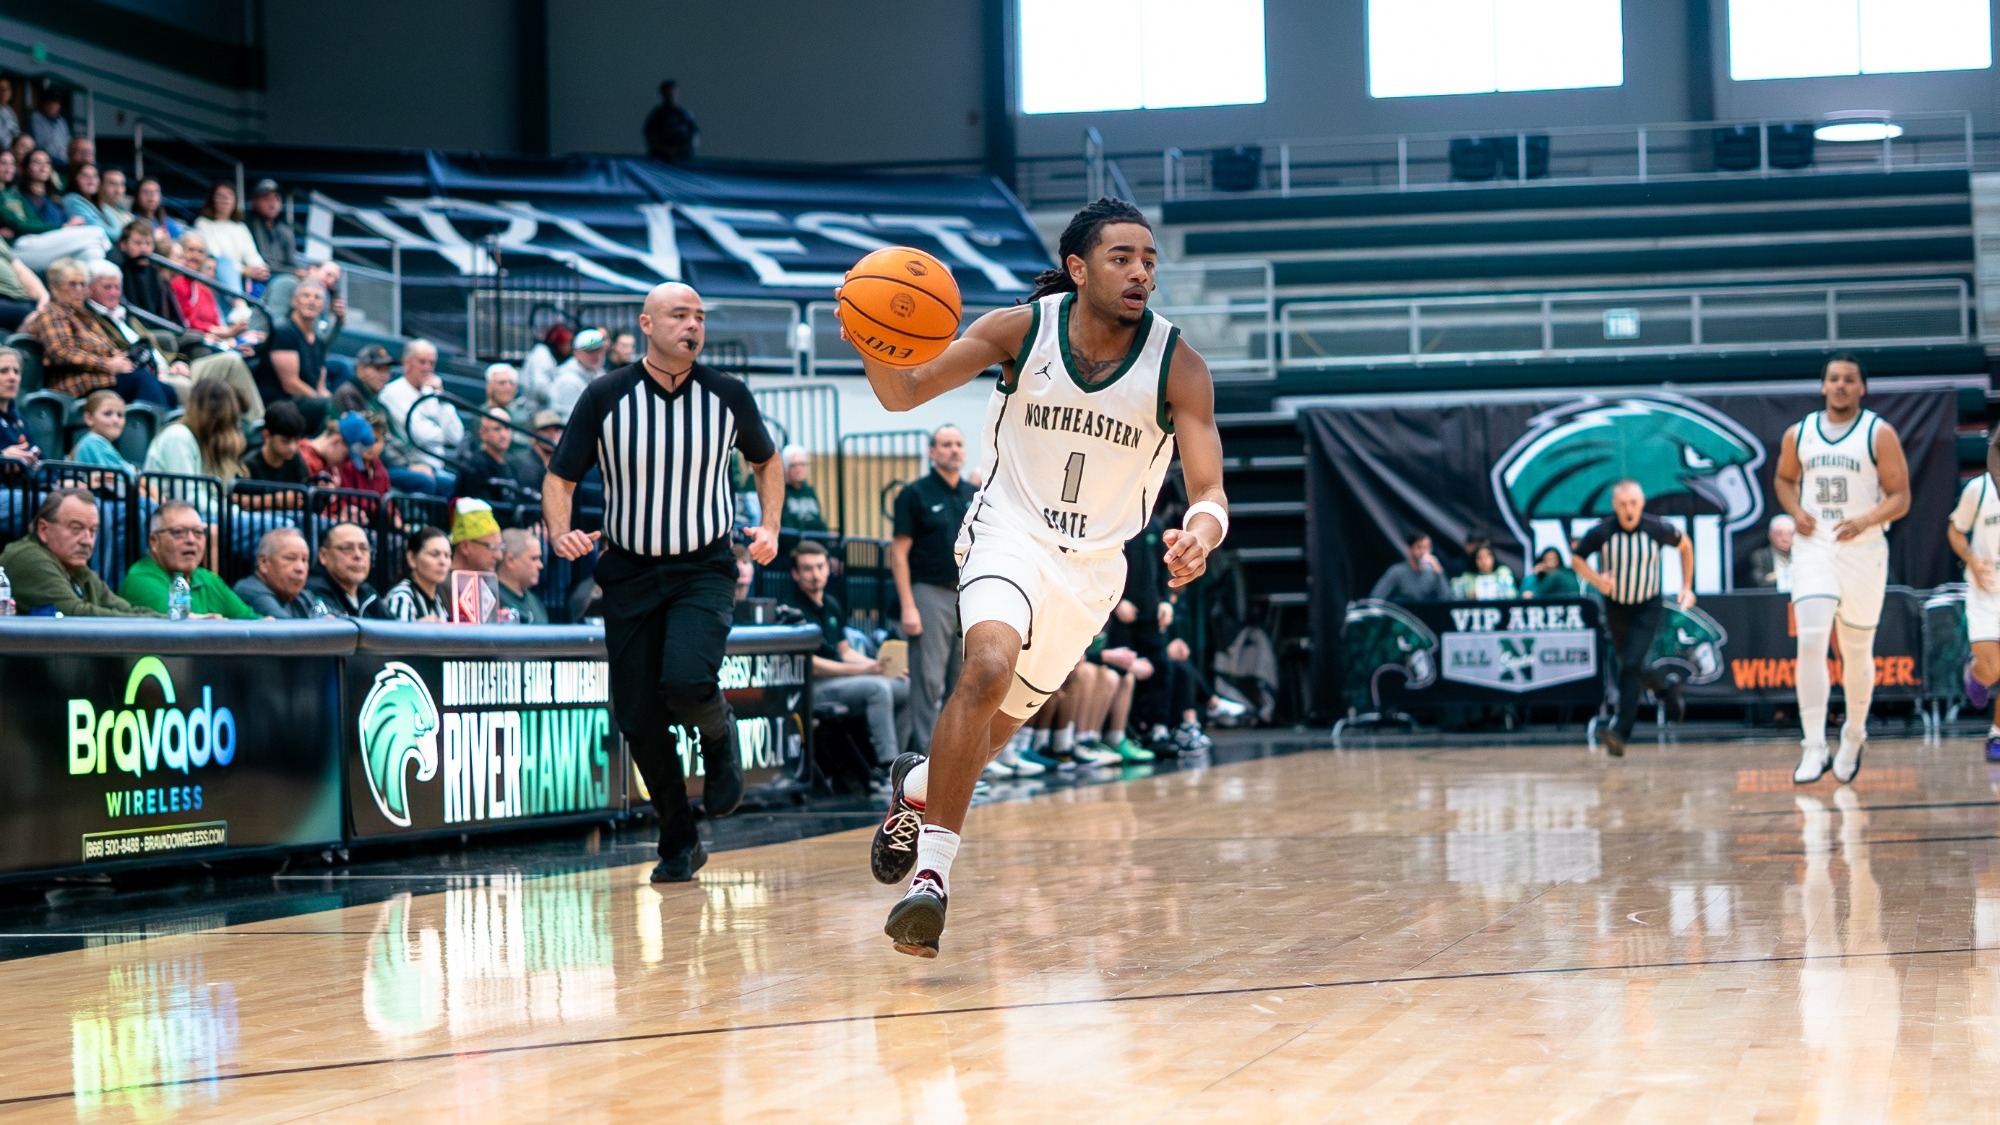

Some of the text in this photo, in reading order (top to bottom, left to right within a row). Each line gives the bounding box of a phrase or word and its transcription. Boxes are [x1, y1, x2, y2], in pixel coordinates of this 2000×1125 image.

[866, 336, 914, 359] EVO
[1024, 403, 1142, 449] NORTHEASTERN
[1061, 451, 1086, 504] 1
[1043, 507, 1088, 538] STATE
[1450, 605, 1586, 632] VIP AREA
[1538, 647, 1590, 666] CLUB
[524, 661, 553, 704] STATE
[67, 684, 238, 779] Bravado
[442, 707, 610, 823] RIVERHAWKS
[105, 785, 203, 818] WIRELESS
